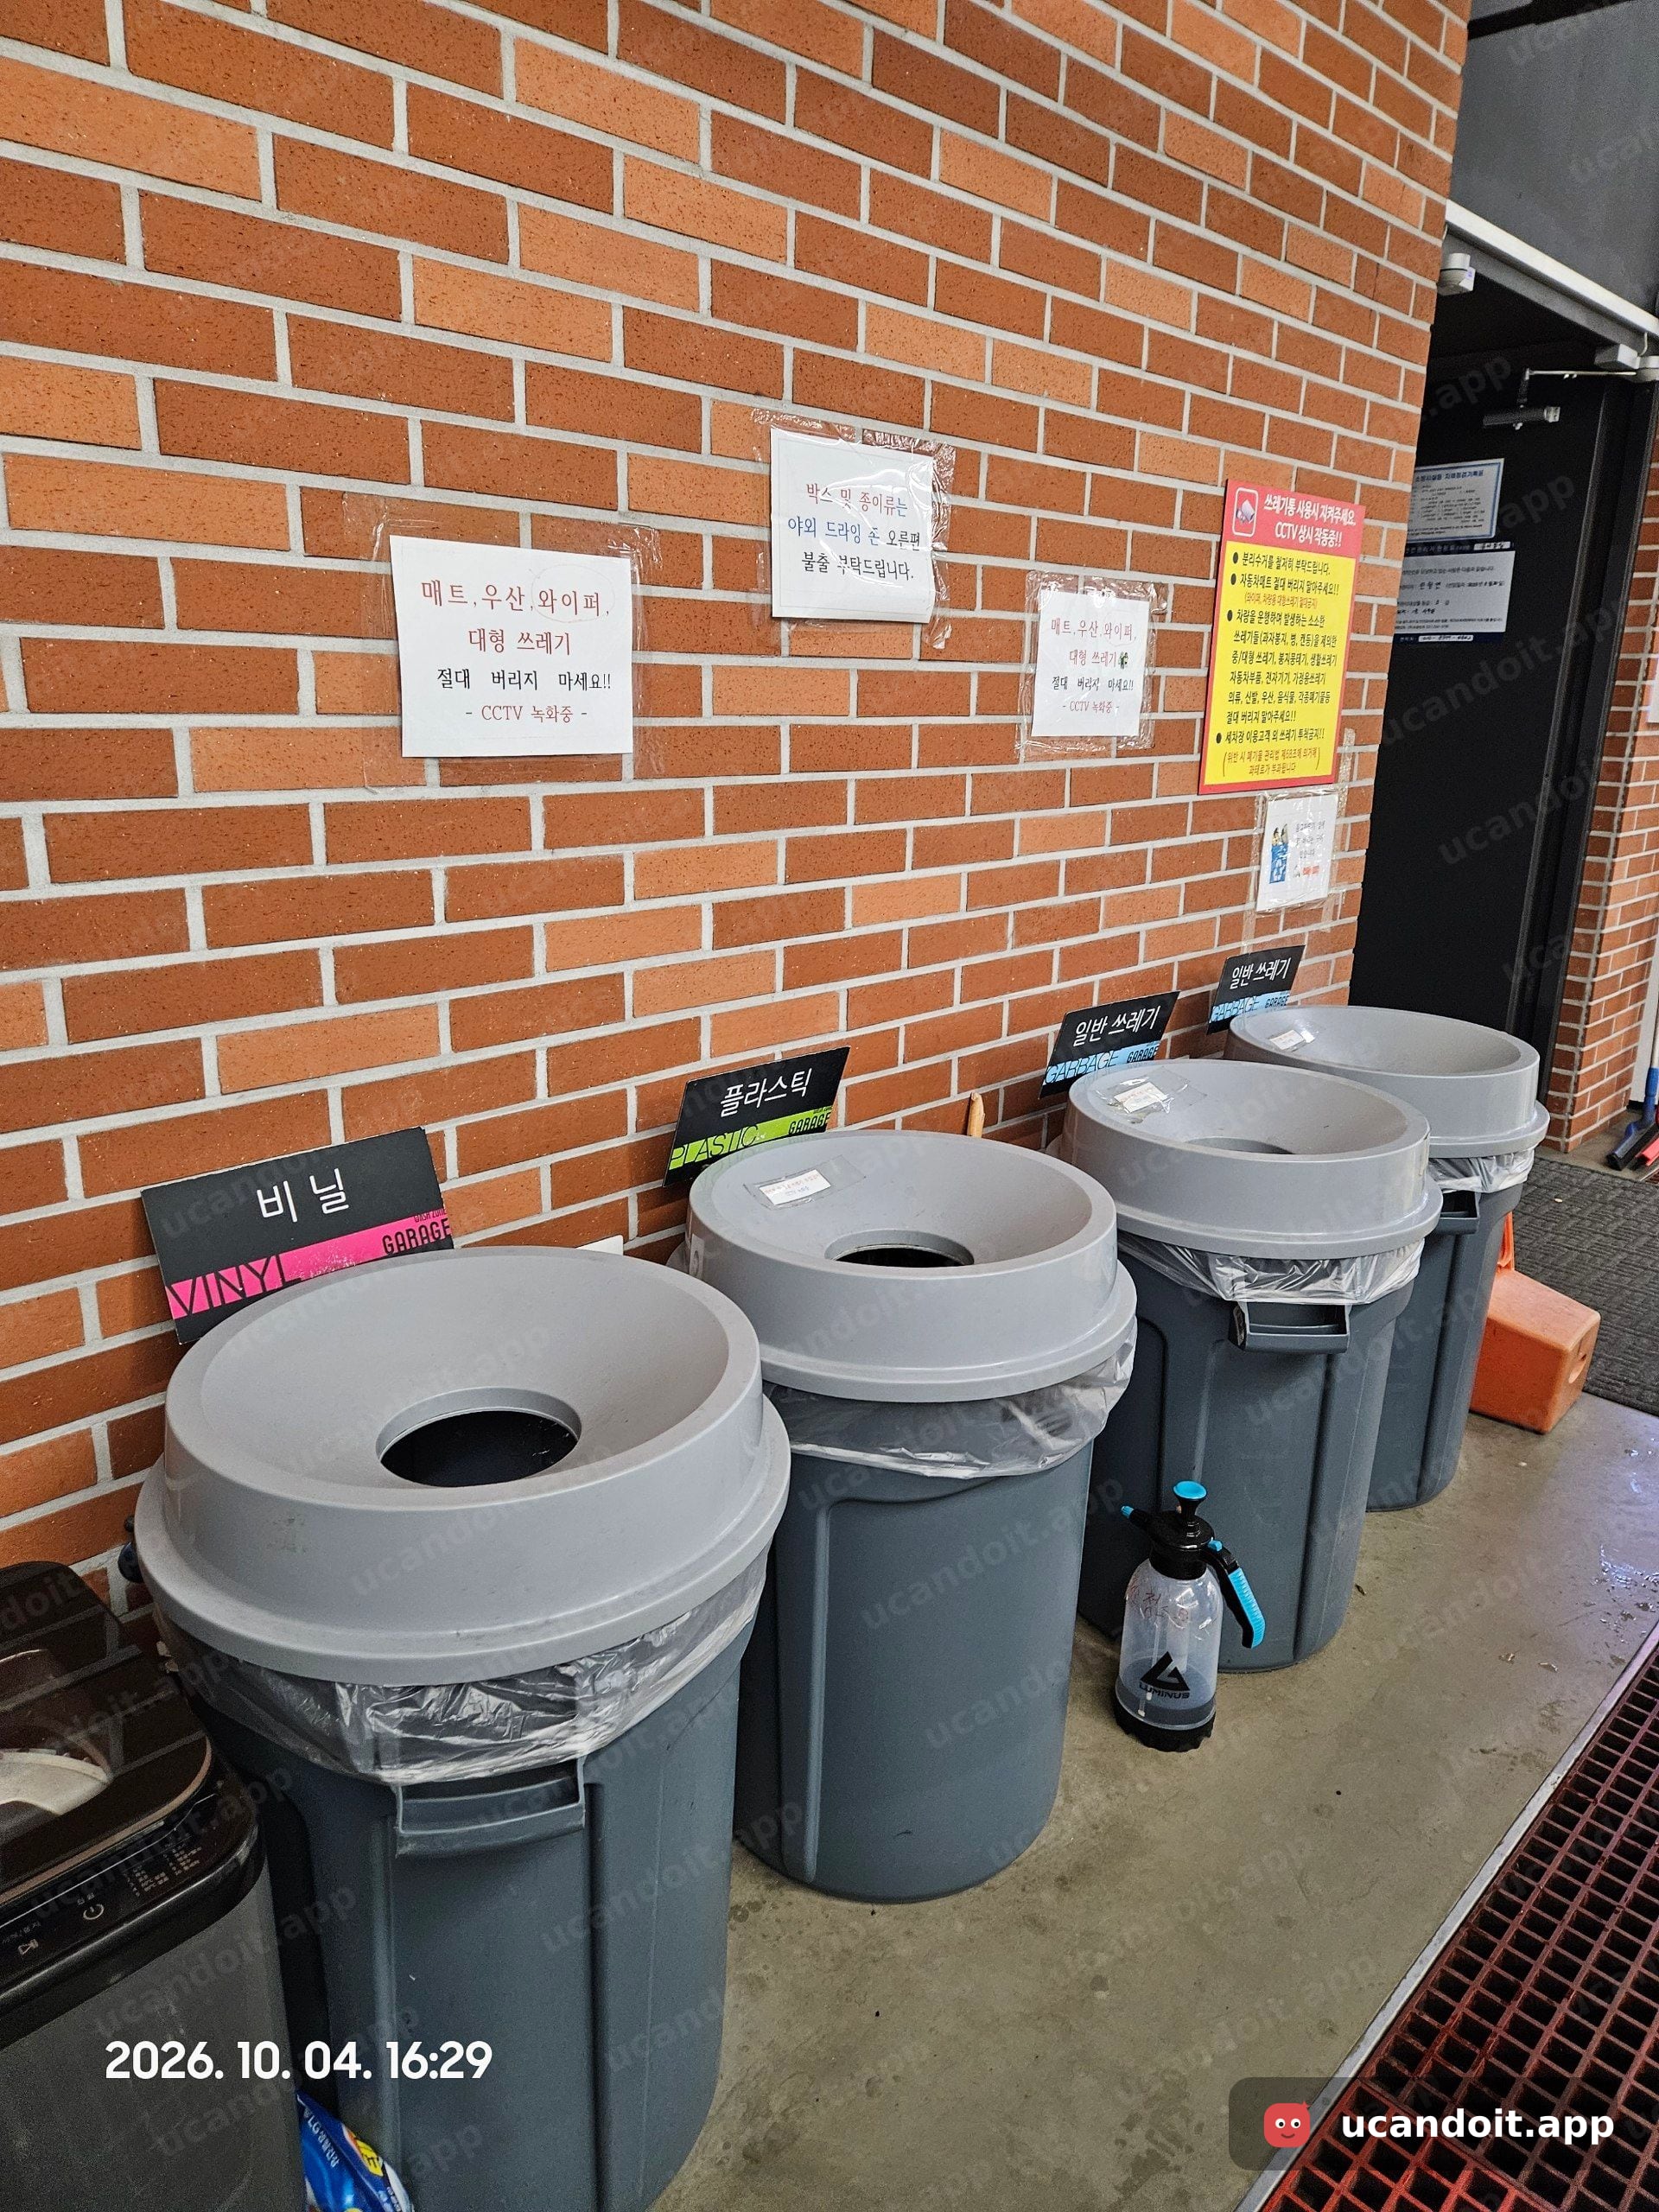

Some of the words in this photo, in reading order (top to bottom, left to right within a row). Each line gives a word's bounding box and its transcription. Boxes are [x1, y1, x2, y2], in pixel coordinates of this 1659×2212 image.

[807, 483, 833, 504] 박스
[859, 491, 908, 517] 종이류는
[1264, 493, 1296, 517] 쓰레기통
[1297, 499, 1319, 522] 사용시
[788, 516, 817, 537] 야외
[824, 522, 861, 544] 드라잉
[886, 530, 920, 551] 오른편
[1274, 522, 1300, 539] CCTV
[1299, 524, 1314, 545] 상시
[1314, 527, 1343, 547] 작동중!!
[836, 556, 914, 581] 부탁드립니다.
[1243, 552, 1274, 570] 분리수거를
[1275, 556, 1294, 572] 철저히
[1295, 559, 1331, 576] 부탁드립니다.
[1240, 573, 1272, 590] 자동차매트
[1274, 576, 1286, 592] 절대
[1287, 578, 1305, 593] 버리지
[1306, 582, 1339, 596] 말아주세요!!
[1284, 612, 1306, 627] 발생하는
[469, 628, 505, 652] 대형
[517, 632, 570, 655] 쓰레기
[1069, 649, 1087, 666] 대형
[1091, 652, 1116, 668] 쓰레기
[437, 668, 470, 689] 절대
[492, 670, 537, 690] 버리지
[558, 671, 612, 690] 마세요!!
[1052, 676, 1068, 690] 절대
[1077, 677, 1100, 691] 버리지
[1108, 678, 1134, 692] 마세요!!
[481, 705, 523, 721] CCTV
[531, 706, 573, 722] 녹화중
[1070, 701, 1090, 712] CCTV
[1092, 701, 1113, 714] 녹화중
[1227, 710, 1239, 724] 절대
[1241, 710, 1260, 723] 버리지
[1262, 710, 1296, 723] 말아주세요!!
[1246, 728, 1270, 743] 이용고객
[1279, 729, 1296, 741] 쓰레기
[1230, 963, 1255, 989] 일반
[1253, 957, 1292, 981] 쓰레기
[1073, 1016, 1108, 1046] 일반
[1108, 1006, 1160, 1034] 쓰레기
[1045, 1052, 1118, 1084] GARBAGE
[1127, 1046, 1160, 1063] GARAGE
[721, 1068, 812, 1117] 플라스틱
[669, 1125, 759, 1169] PLASTIC
[788, 1112, 831, 1135] GARAGE
[165, 1255, 302, 1314] VINYL
[382, 1217, 451, 1255] GARAGE
